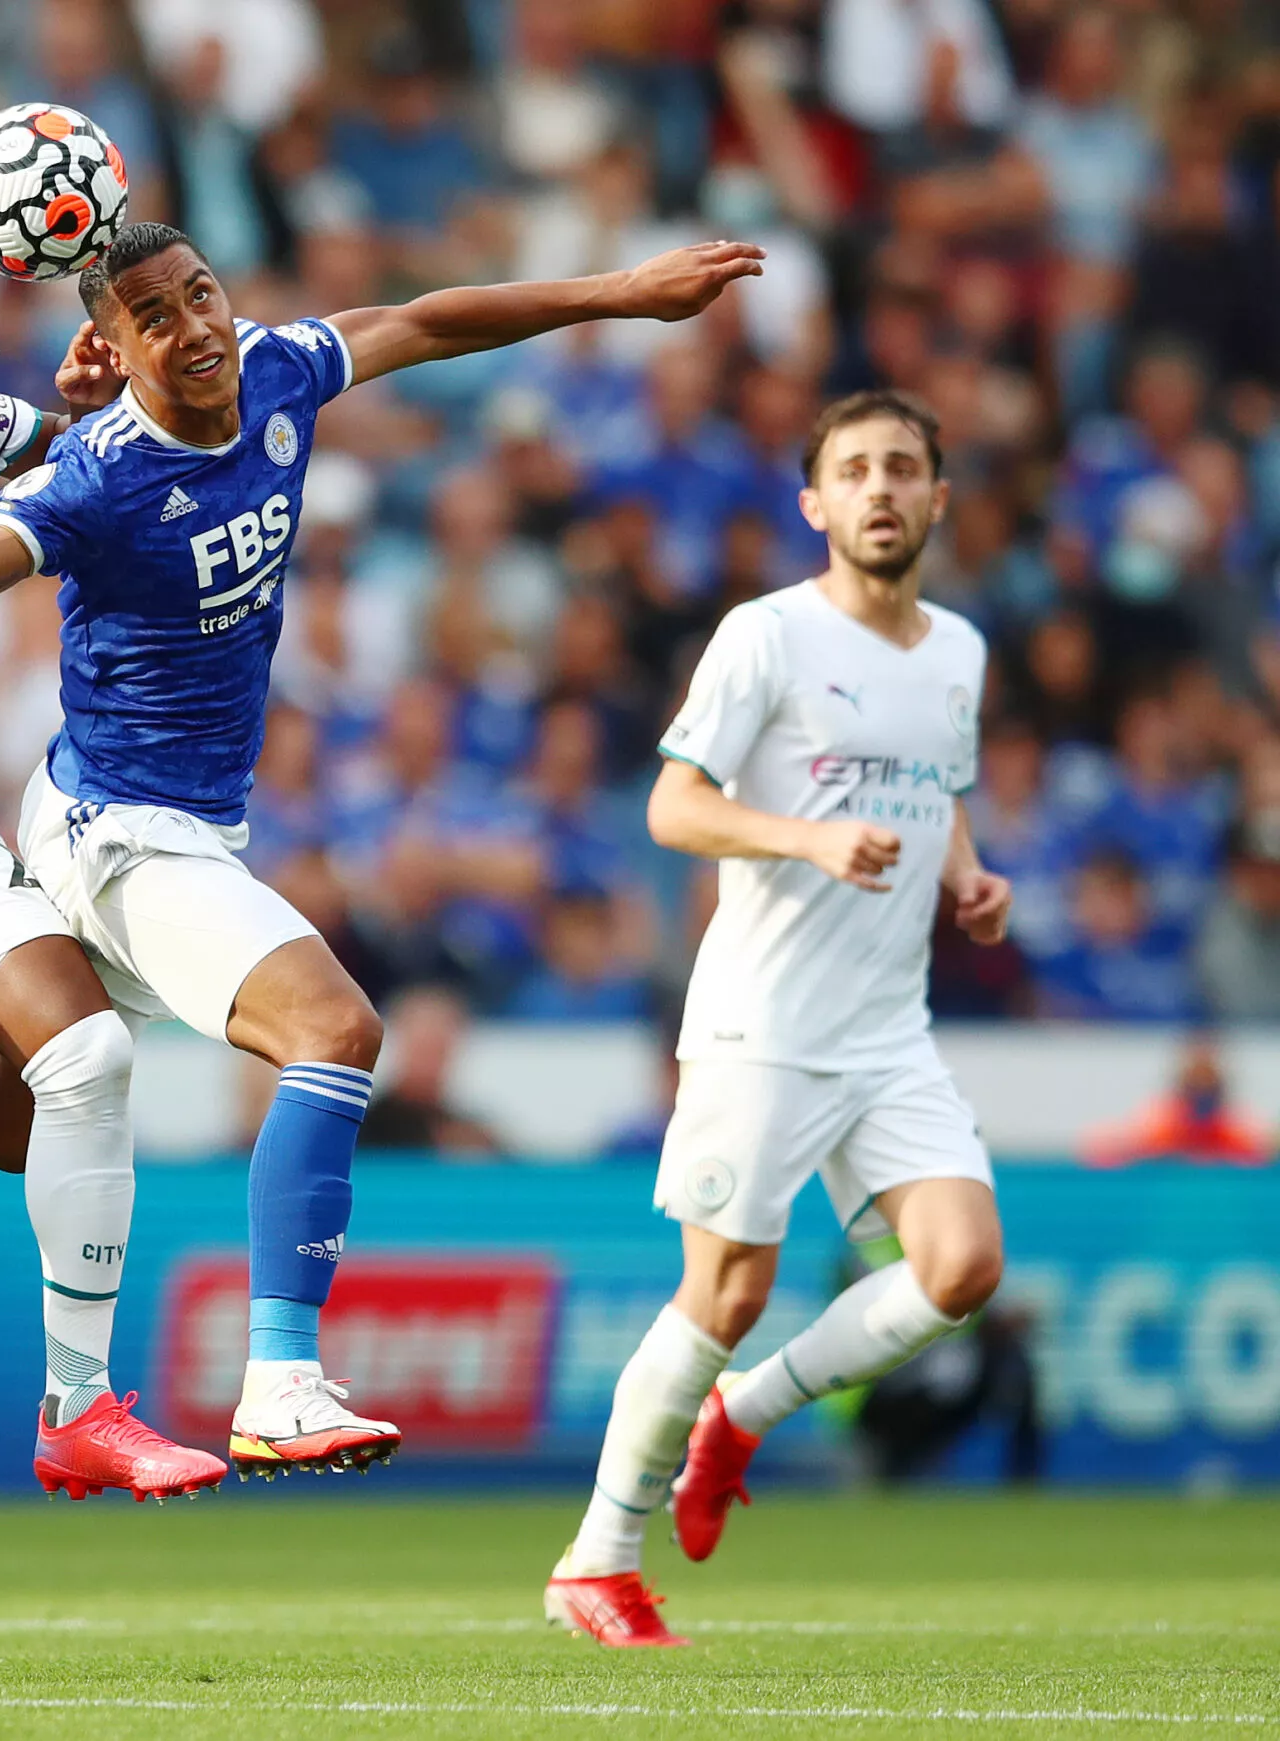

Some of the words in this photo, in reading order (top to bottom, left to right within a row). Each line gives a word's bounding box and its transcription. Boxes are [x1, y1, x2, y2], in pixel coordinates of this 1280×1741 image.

[160, 500, 199, 523] adidas
[189, 493, 292, 590] FBS
[199, 605, 250, 634] trade
[81, 1242, 126, 1265] CITY
